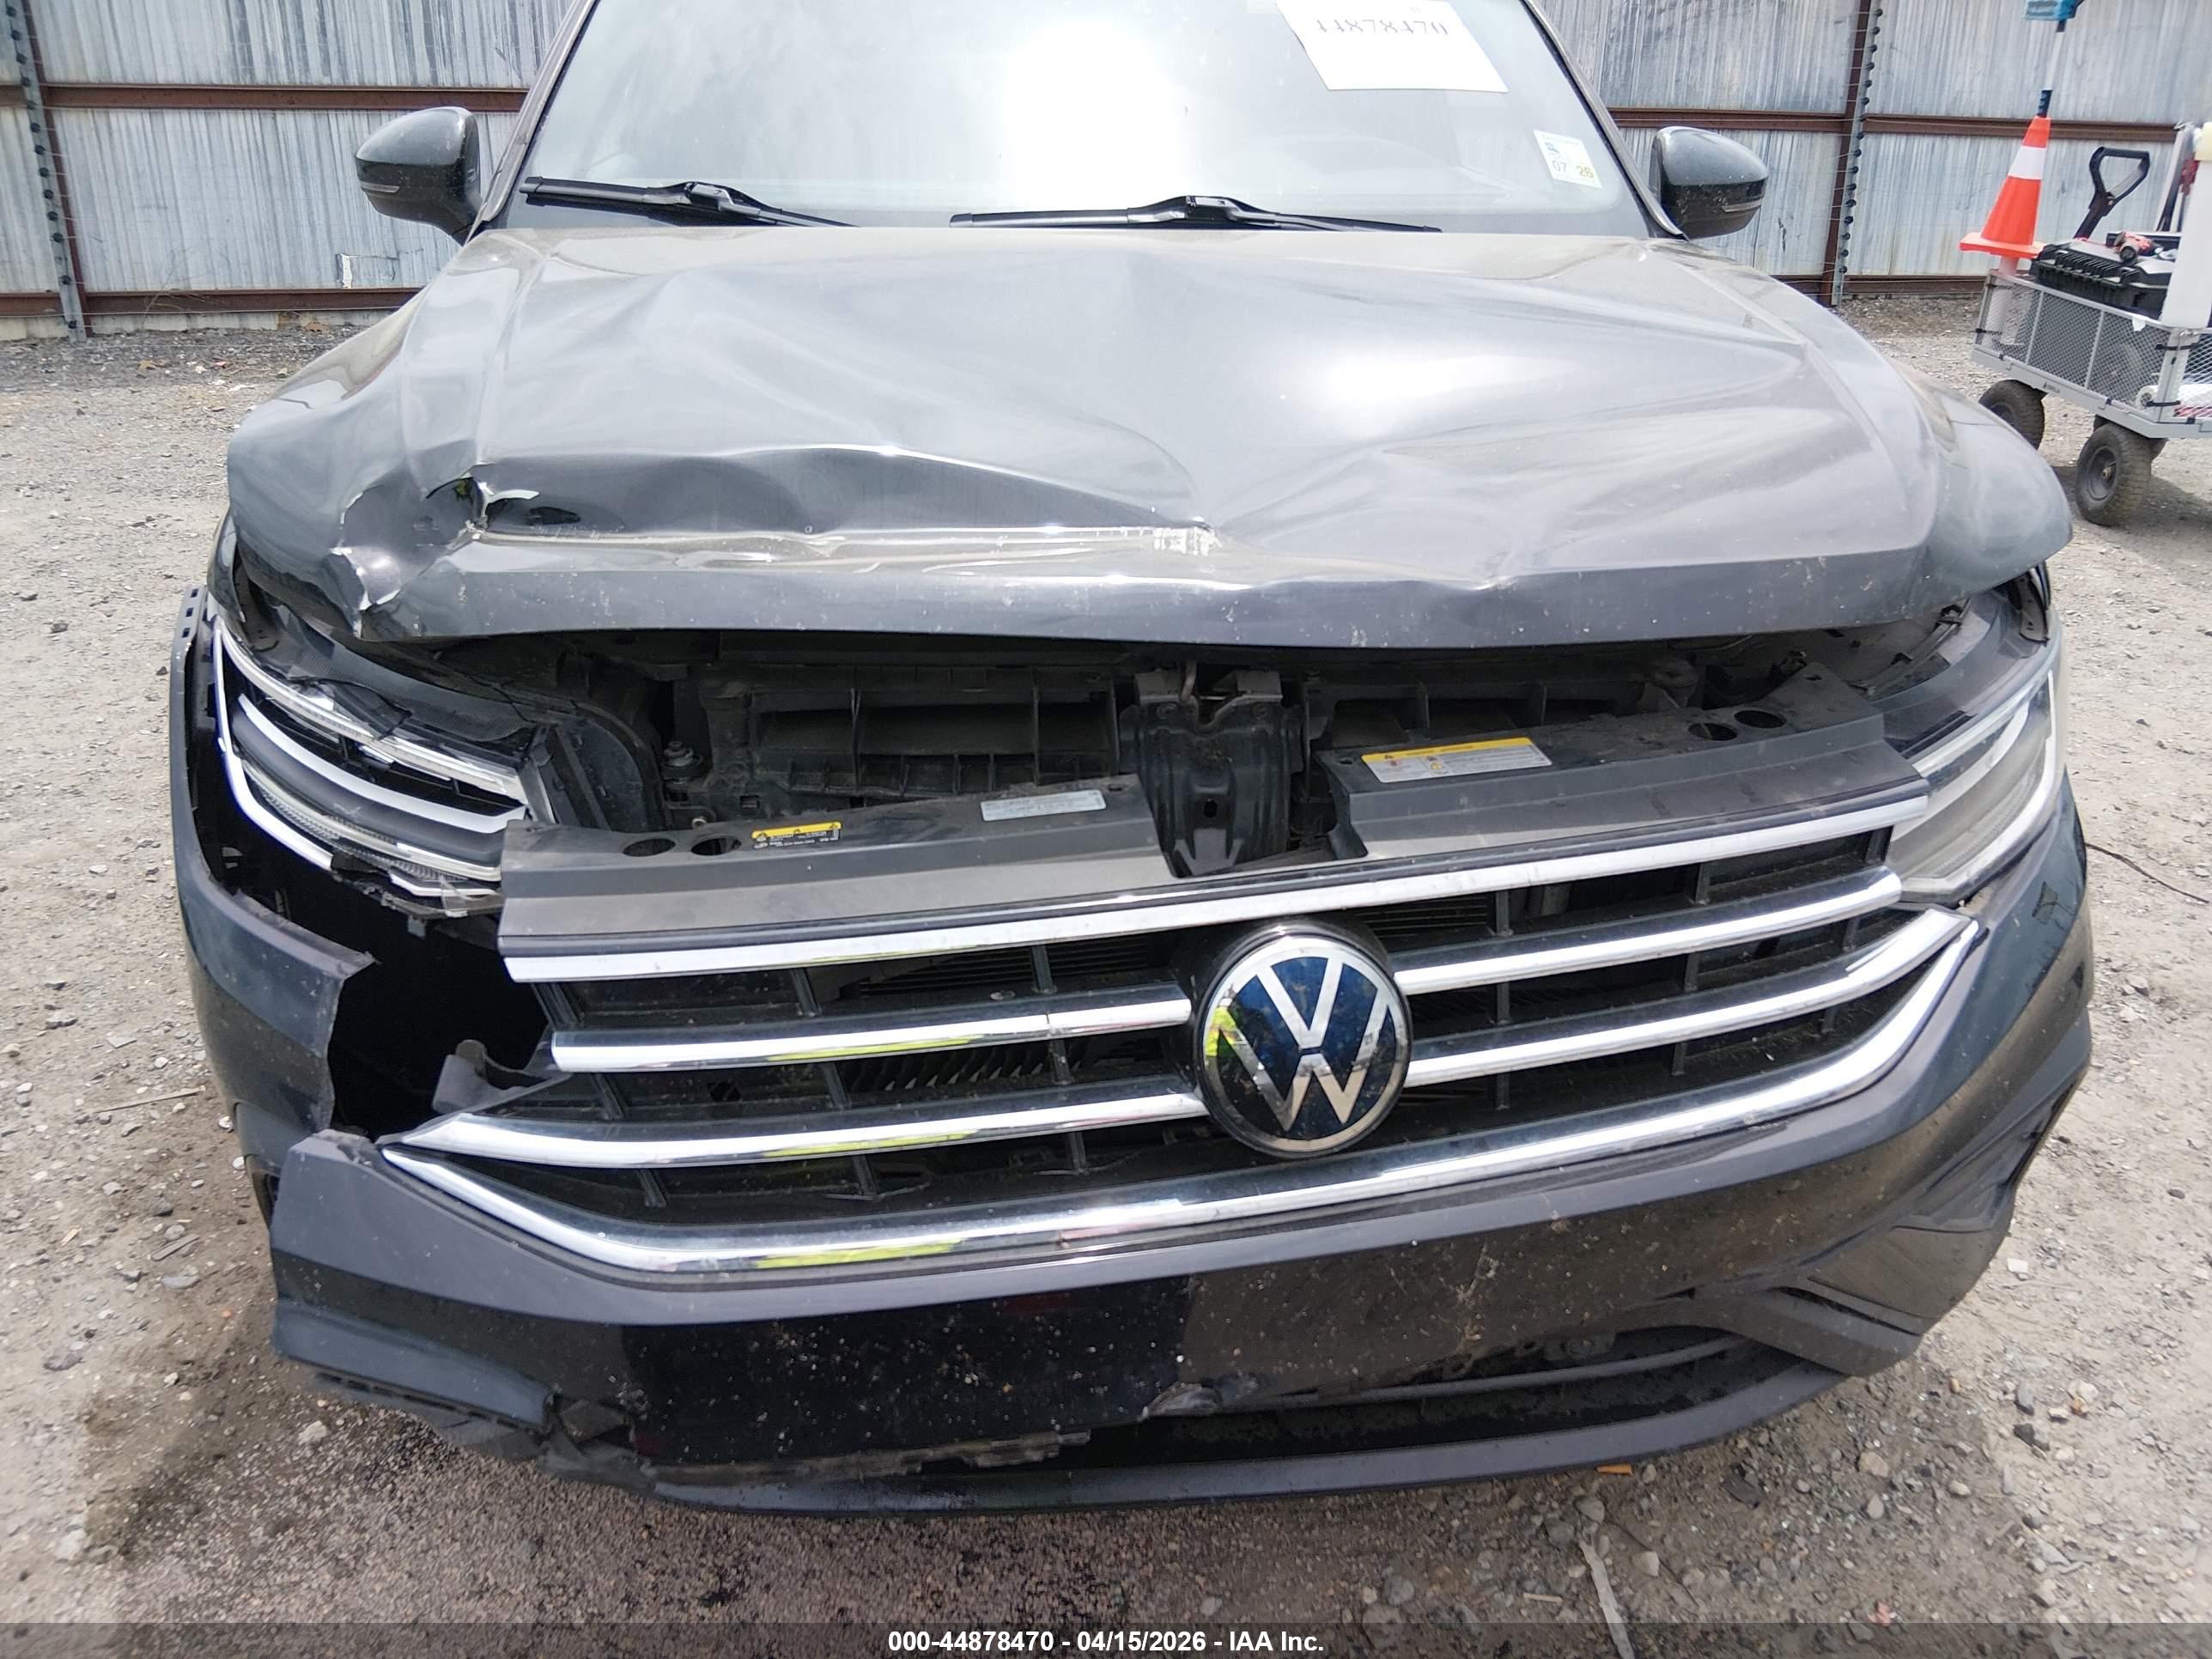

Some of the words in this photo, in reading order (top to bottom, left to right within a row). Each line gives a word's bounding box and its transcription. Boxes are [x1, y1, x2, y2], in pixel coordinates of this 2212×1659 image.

[1552, 160, 1567, 173] 07
[1576, 165, 1595, 179] 26
[1206, 945, 1400, 1138] VW
